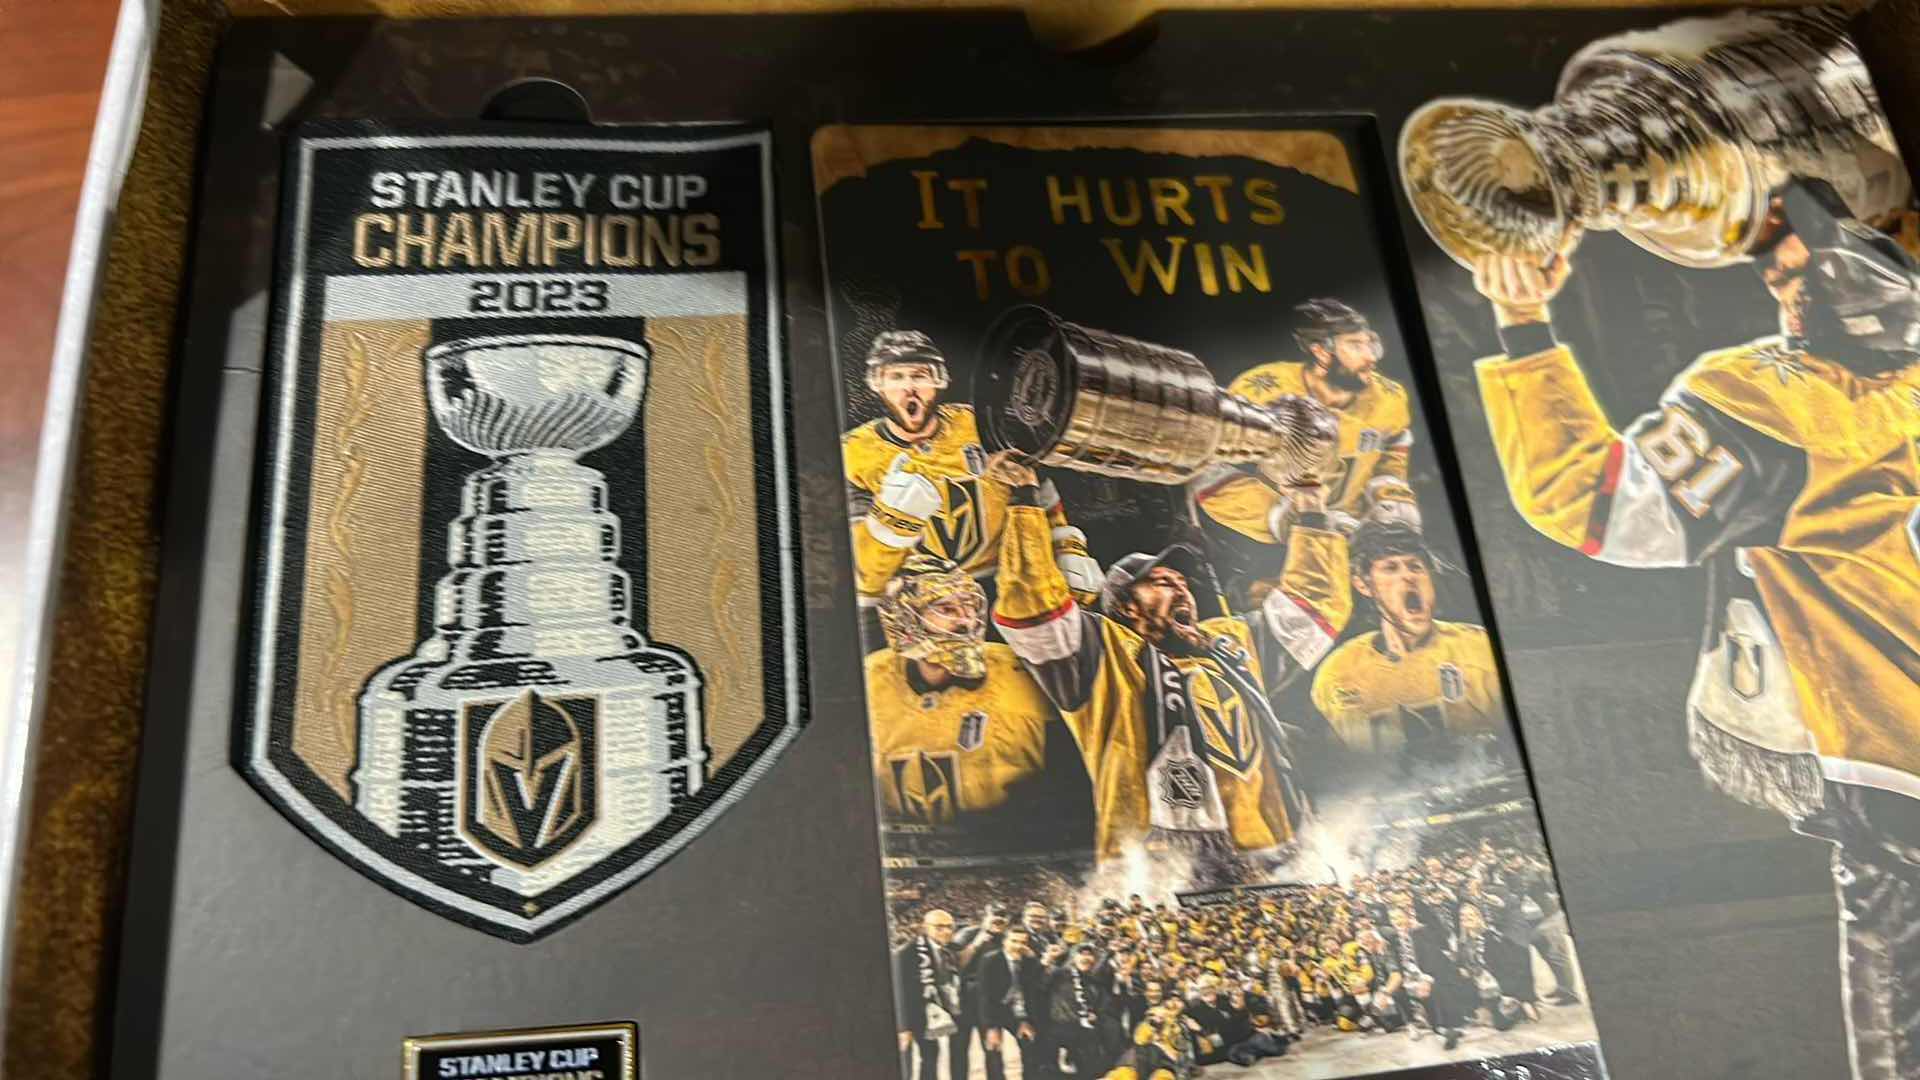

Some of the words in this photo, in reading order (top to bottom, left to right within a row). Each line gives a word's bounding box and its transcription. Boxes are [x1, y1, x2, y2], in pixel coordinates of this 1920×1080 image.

[371, 171, 598, 209] STANLEY
[608, 174, 708, 210] CUP
[911, 170, 987, 229] IT
[1045, 174, 1286, 227] HURTS
[352, 212, 721, 268] CHAMPIONS
[956, 245, 1051, 301] TO
[1100, 236, 1272, 297] WIN
[468, 280, 609, 314] 2023
[1636, 404, 1744, 520] 61
[438, 1051, 545, 1077] STANLEY
[549, 1047, 599, 1069] CUP
